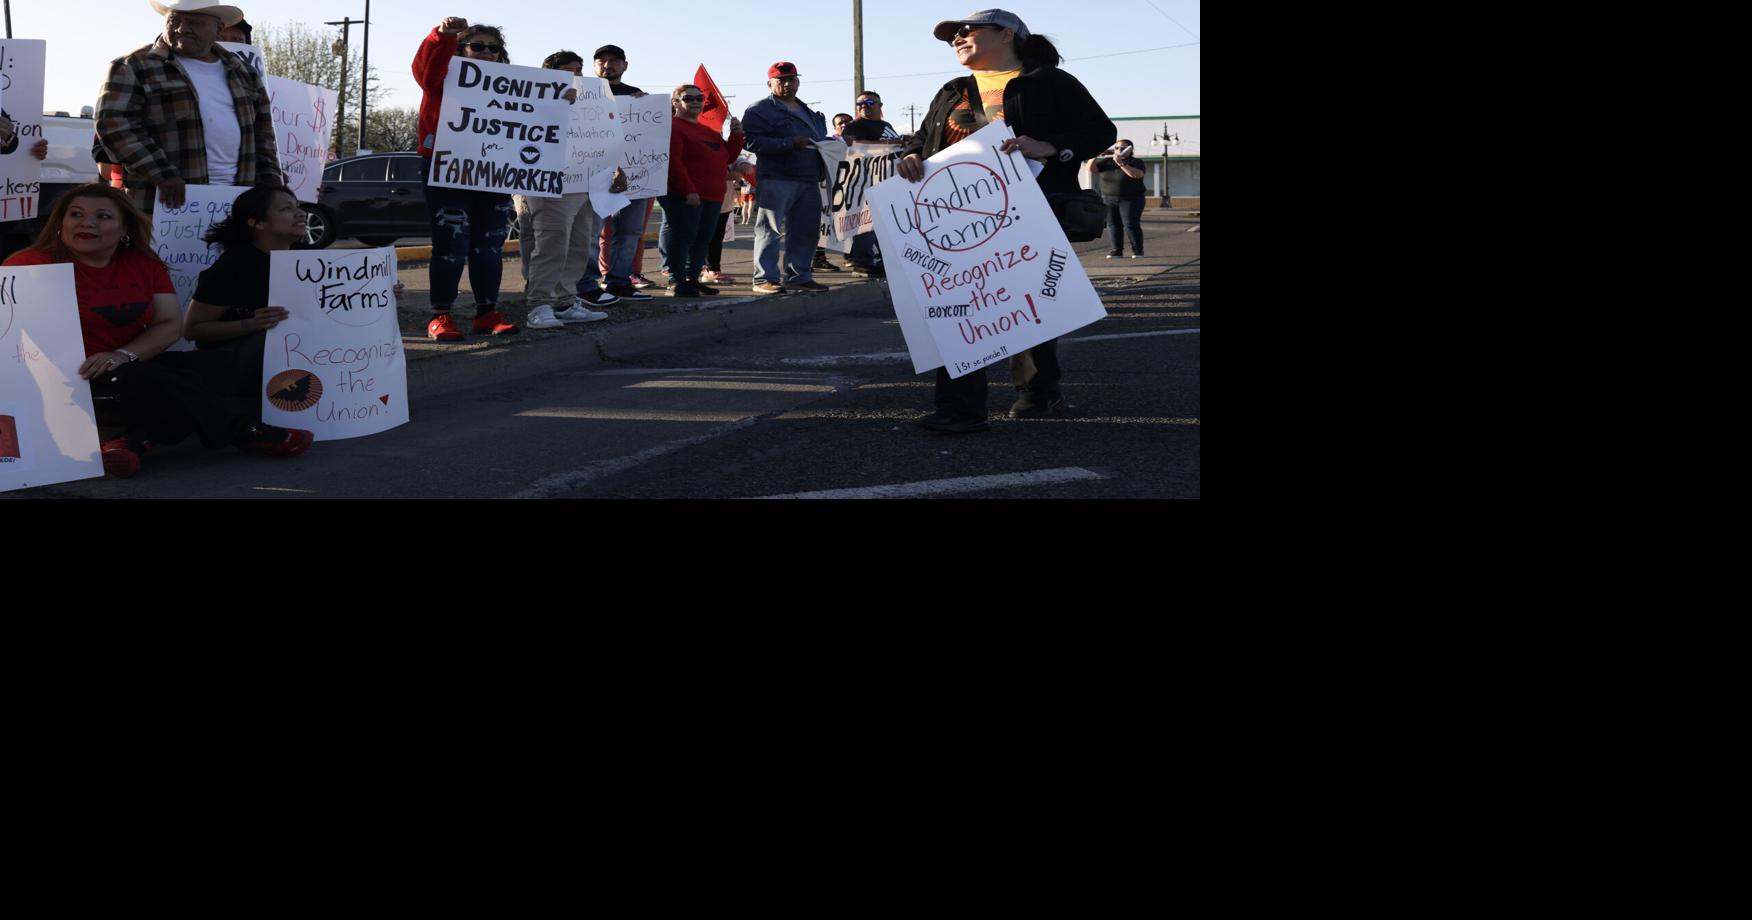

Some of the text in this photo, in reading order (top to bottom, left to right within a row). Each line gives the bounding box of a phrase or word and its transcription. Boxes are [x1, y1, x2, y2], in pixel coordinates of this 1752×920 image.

[458, 60, 568, 100] DIGNITY
[487, 99, 535, 113] AND
[447, 107, 560, 144] JUSTICE
[481, 142, 504, 157] for
[433, 150, 564, 195] FARMWORKERS
[891, 140, 1022, 235] Windmill
[921, 206, 1020, 255] Farms:
[295, 254, 391, 283] Windmill
[903, 247, 951, 276] BOYCOTT
[920, 244, 1039, 298] Recognize
[1042, 250, 1067, 298] BOYCOTT
[319, 282, 388, 312] Farms
[928, 304, 970, 318] BOYCOTT
[969, 286, 1011, 311] the
[958, 294, 1042, 344] Union!
[12, 344, 40, 364] the
[973, 359, 982, 367] se
[336, 371, 375, 393] the
